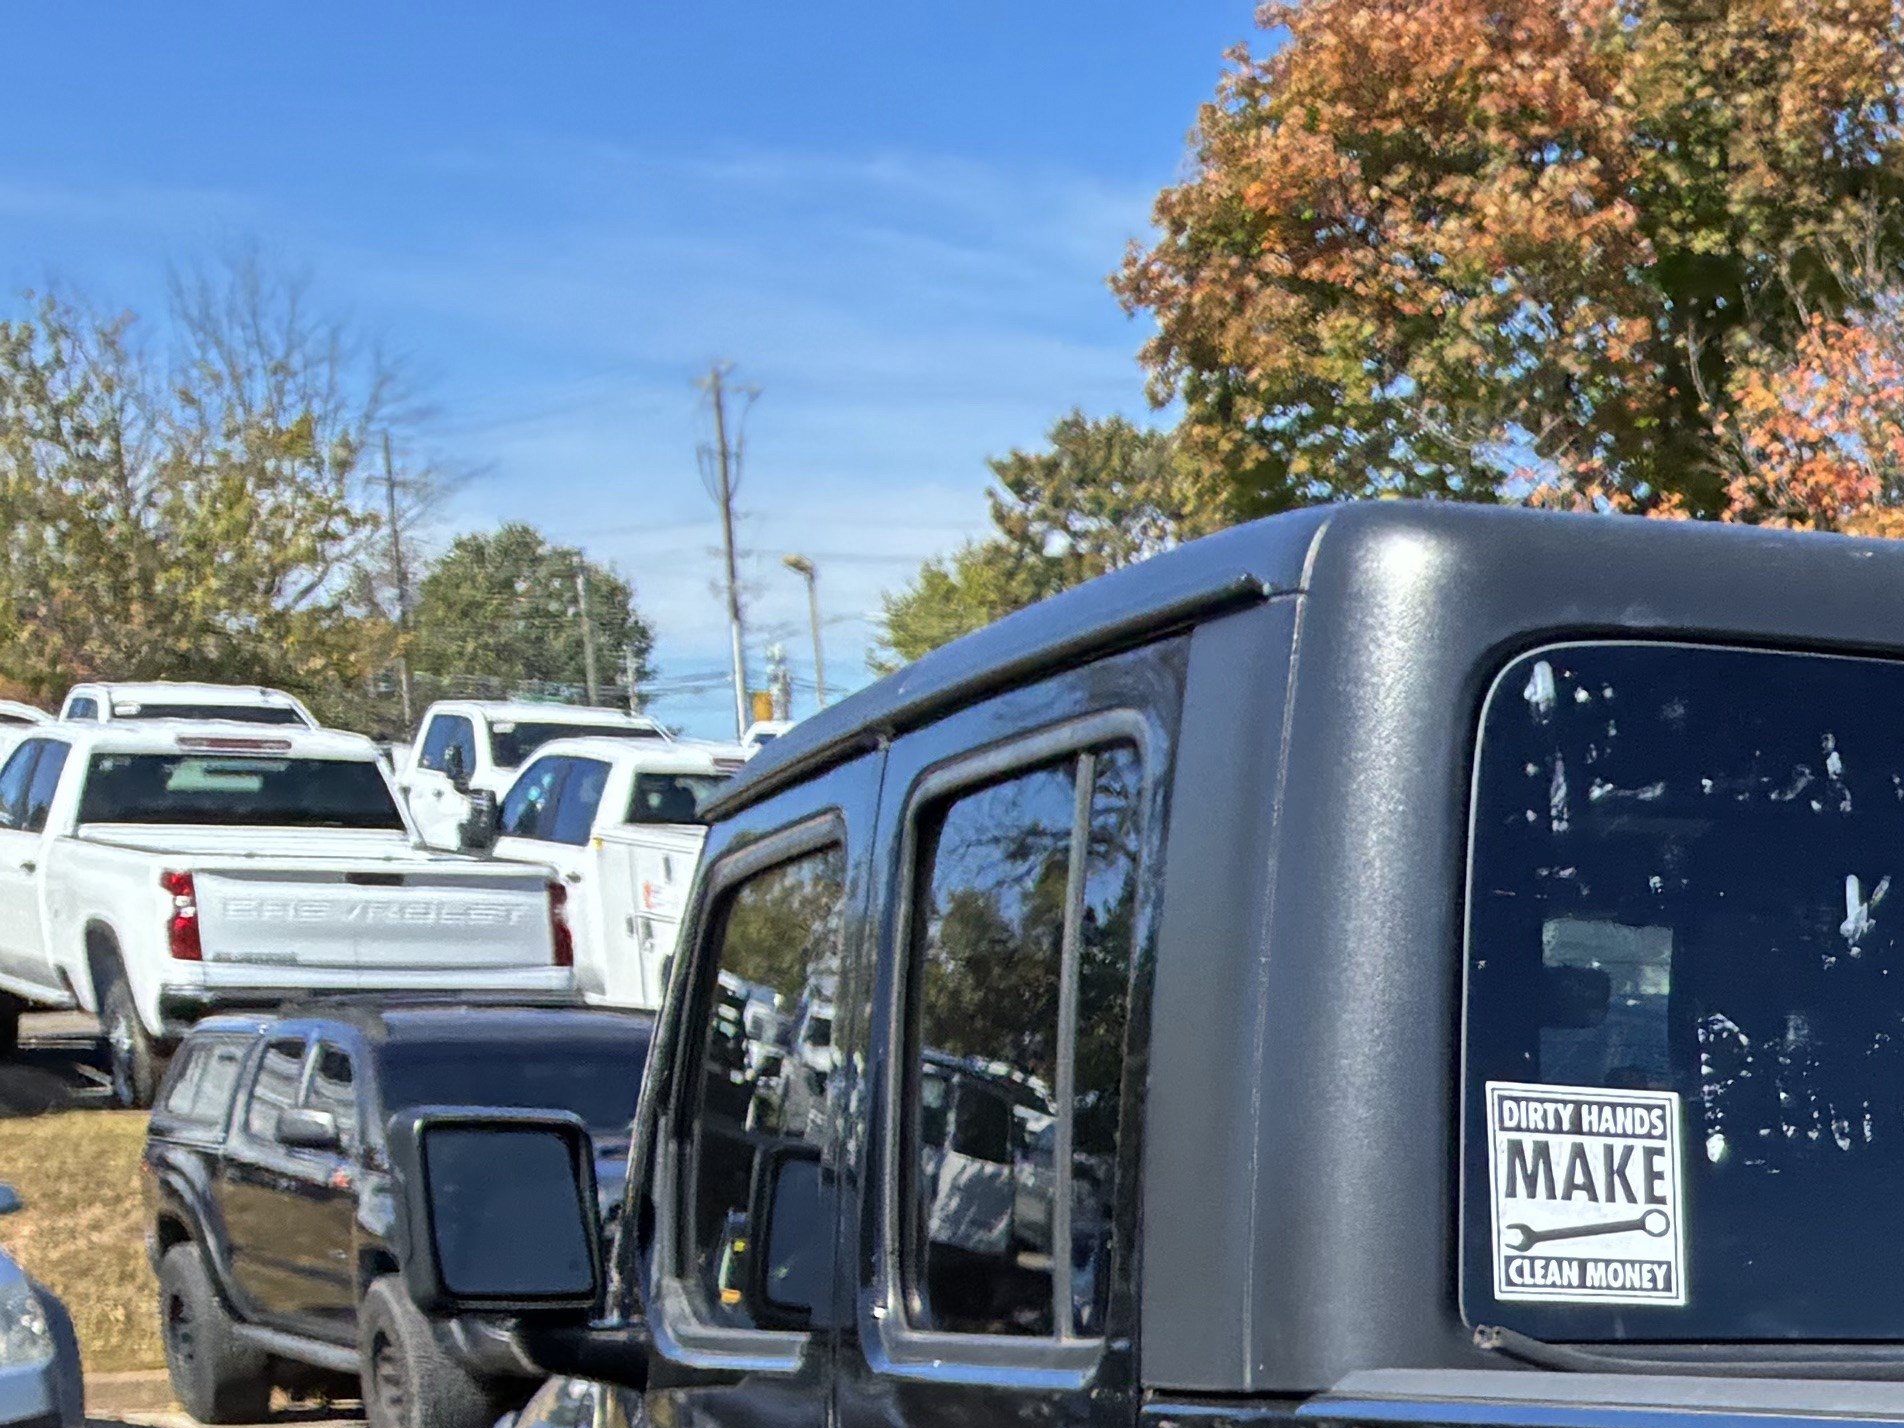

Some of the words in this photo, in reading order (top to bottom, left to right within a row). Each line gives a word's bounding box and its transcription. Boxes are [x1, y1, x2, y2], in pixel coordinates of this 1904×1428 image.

[1502, 1100, 1574, 1131] DIRTY
[1581, 1104, 1665, 1136] HANDS
[1505, 1138, 1668, 1206] MAKE
[1508, 1259, 1579, 1287] CLEAN
[1586, 1262, 1668, 1289] MONEY
